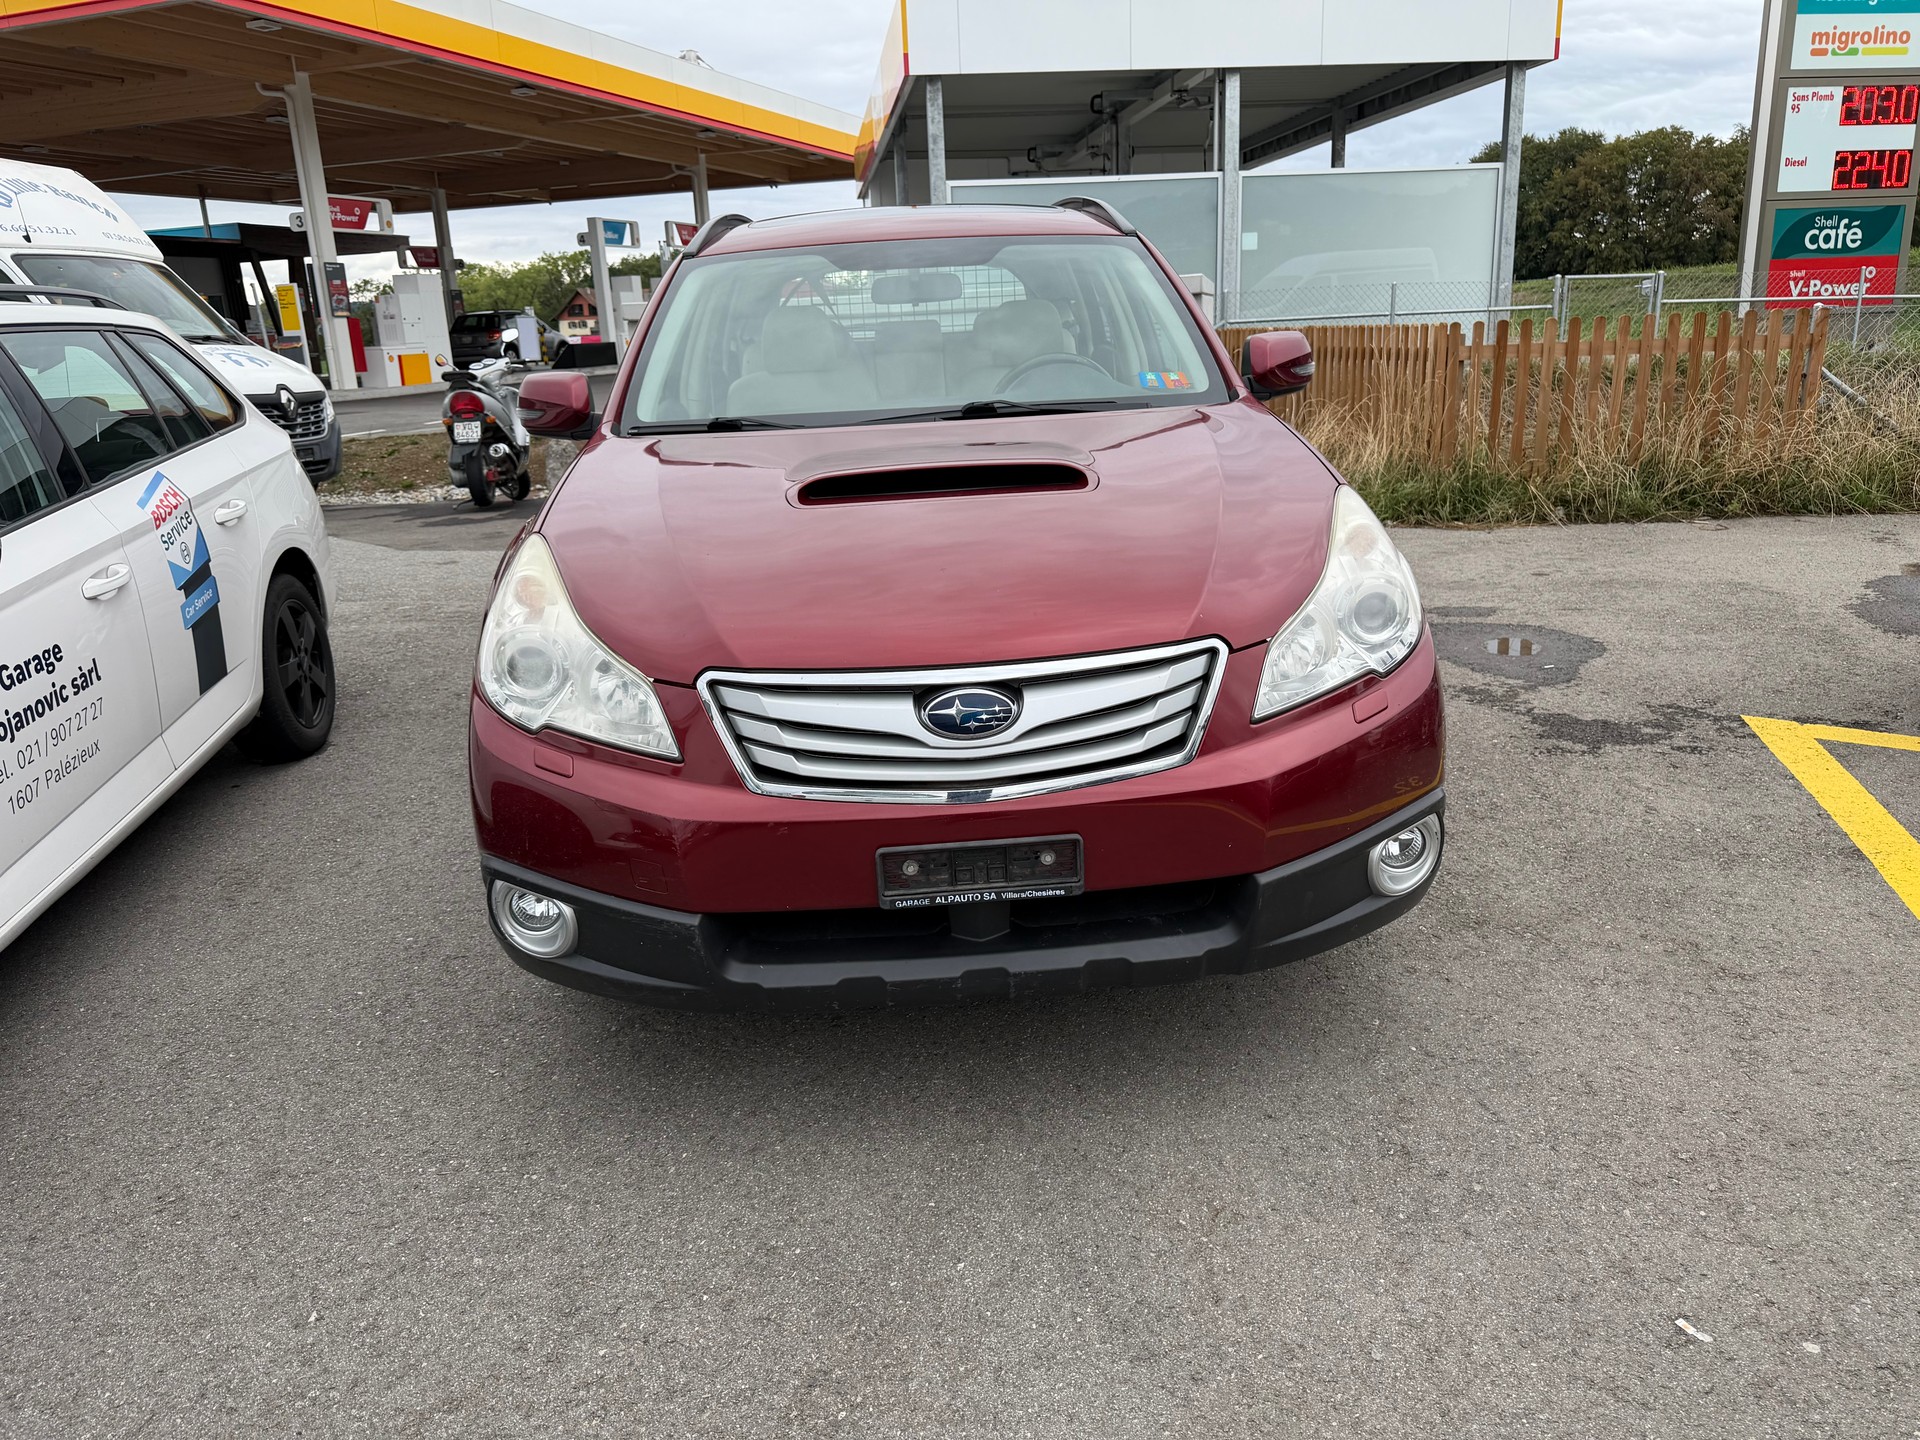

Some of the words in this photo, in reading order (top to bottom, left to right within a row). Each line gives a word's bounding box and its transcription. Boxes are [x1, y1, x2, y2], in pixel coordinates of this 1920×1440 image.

[1811, 25, 1911, 51] migrolino
[1791, 103, 1801, 114] 95
[1792, 91, 1810, 102] Sans
[1811, 90, 1835, 102] Plomb
[1840, 86, 1919, 125] 203.0
[1784, 156, 1808, 168] Diesel
[1833, 150, 1911, 189] 224.0
[295, 215, 304, 228] 3
[1804, 218, 1863, 250] café
[1814, 214, 1839, 228] Shell
[1789, 269, 1806, 278] Shell
[1789, 279, 1871, 298] V-Power
[151, 485, 185, 531] BOSCH
[160, 510, 193, 551] Service
[185, 604, 196, 619] Car
[194, 588, 213, 611] Service
[0, 644, 63, 692] Garage
[71, 657, 102, 697] sàrl
[7, 777, 41, 815] 1607
[44, 739, 101, 790] Palézieux
[895, 898, 930, 908] GARAGE
[935, 893, 981, 904] ALPAUTO
[983, 892, 997, 901] SA
[1000, 888, 1066, 899] Villars/Chesières
